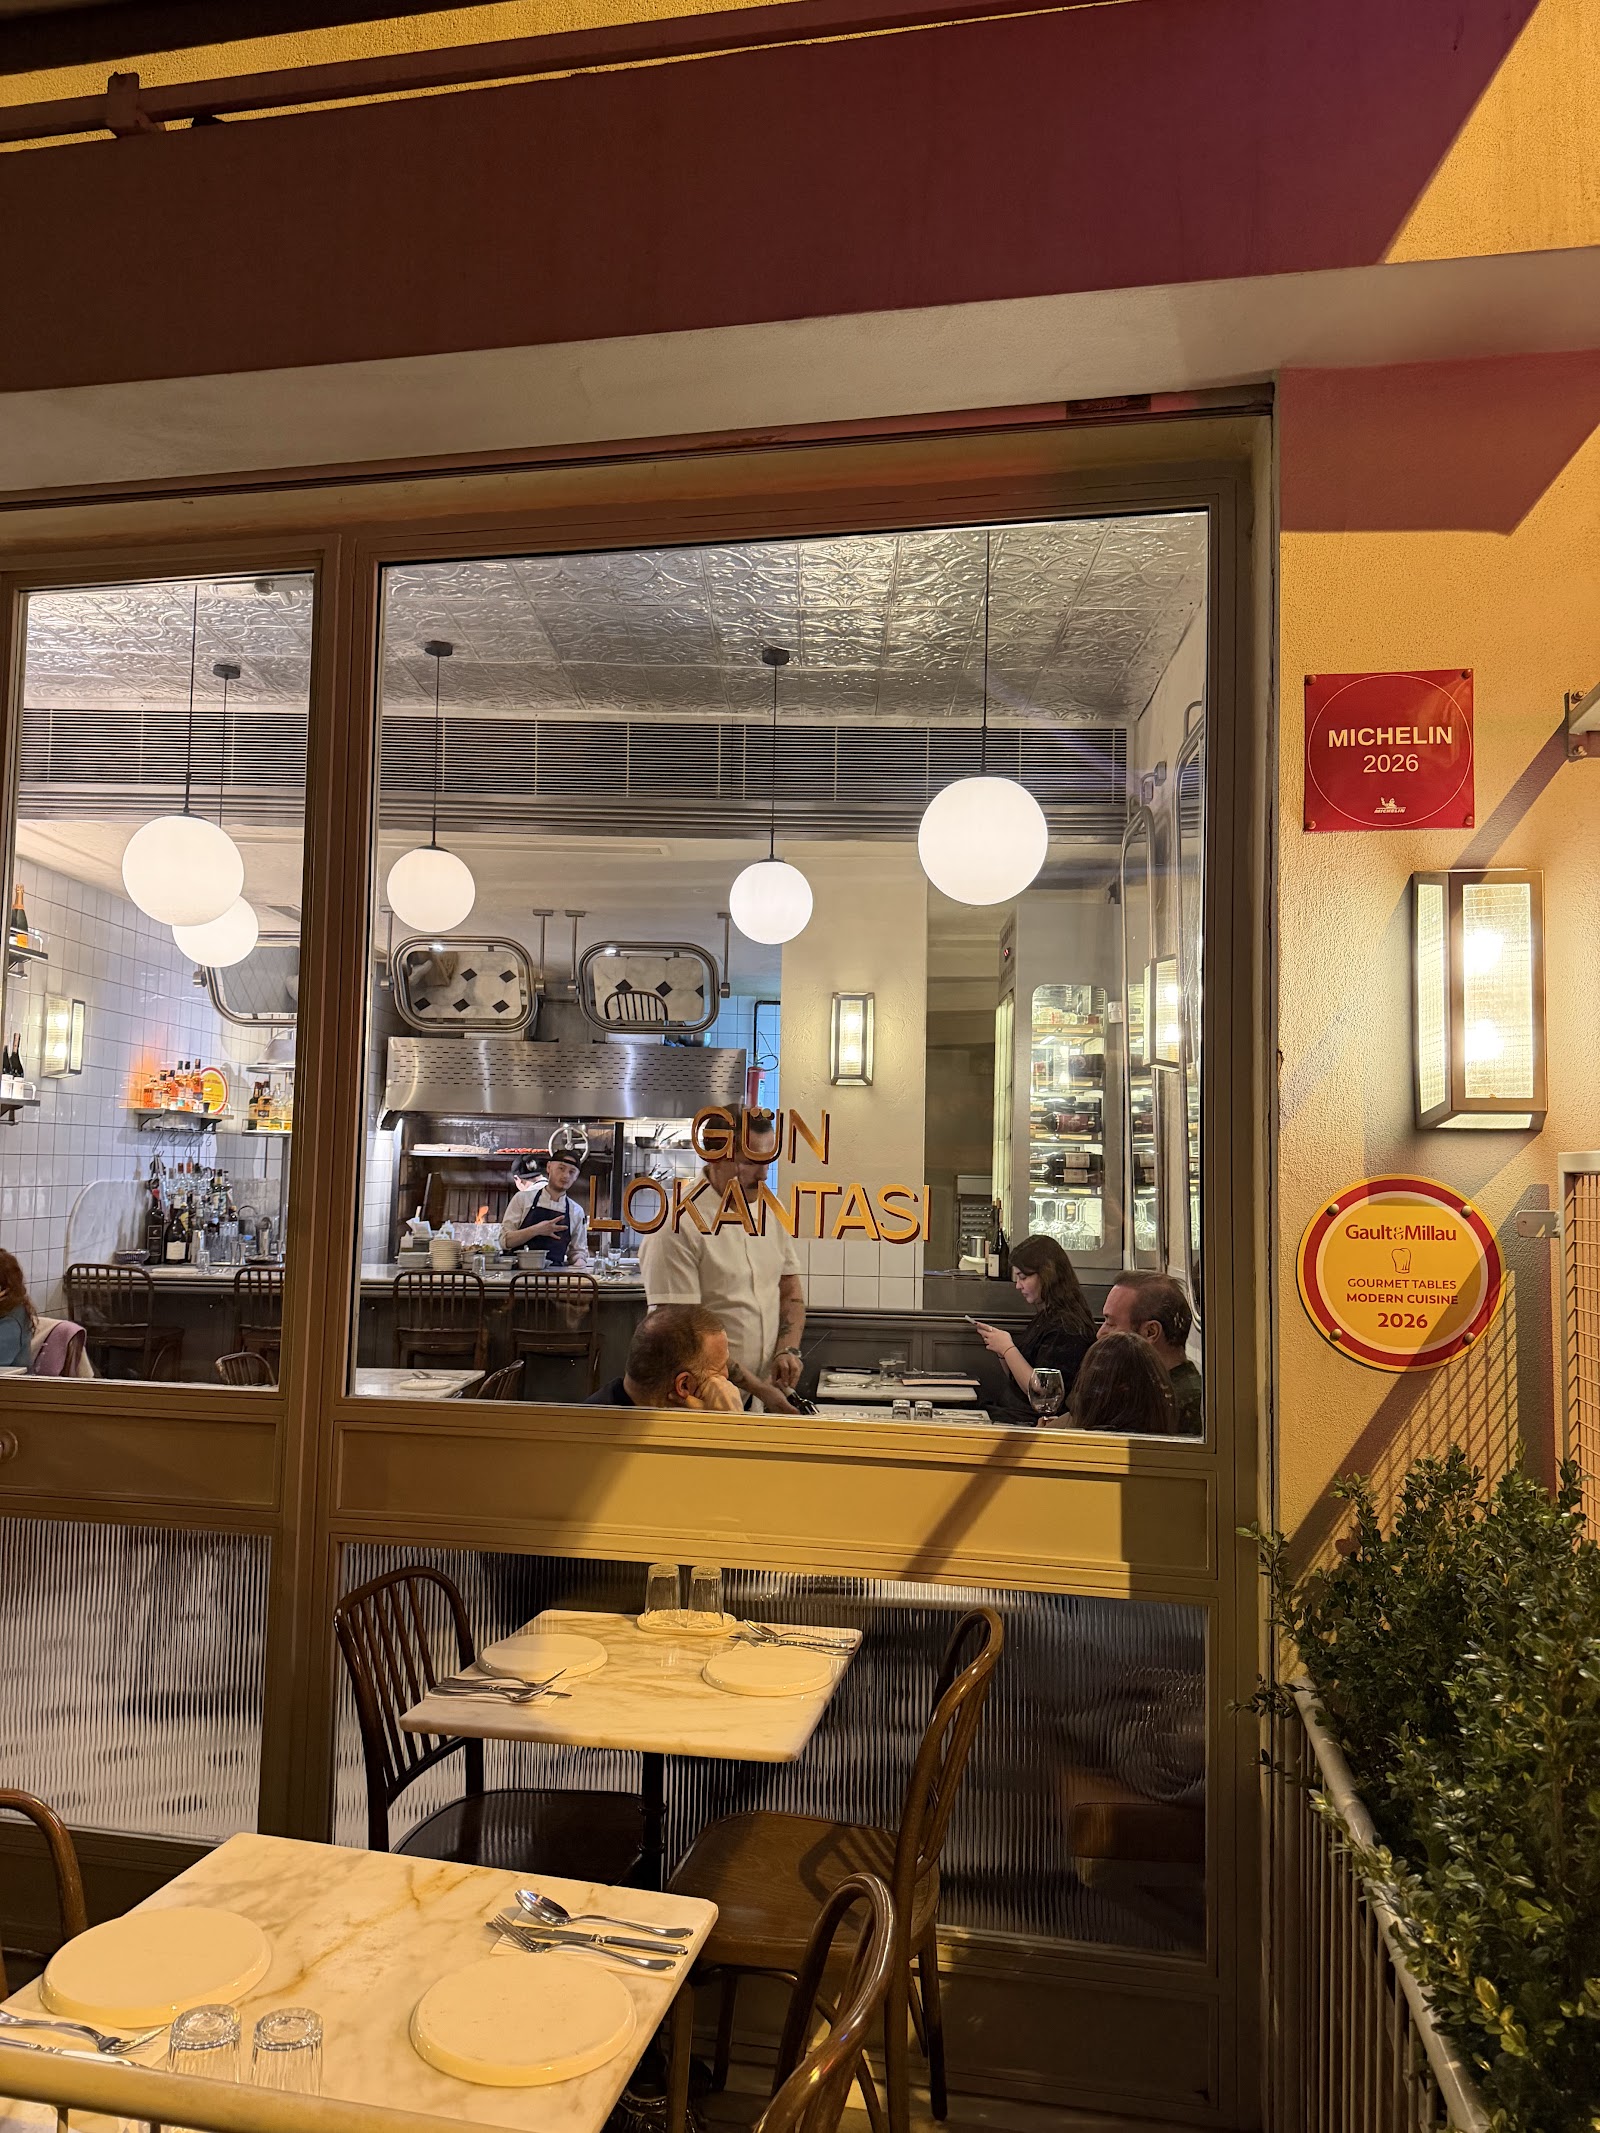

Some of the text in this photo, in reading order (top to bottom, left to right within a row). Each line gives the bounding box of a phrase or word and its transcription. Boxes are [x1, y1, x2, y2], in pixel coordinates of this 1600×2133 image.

[1328, 726, 1452, 748] MICHELIN
[1363, 754, 1419, 773] 2026
[691, 1106, 830, 1164] GÜN
[588, 1175, 931, 1243] LOKANTASI
[1347, 1278, 1457, 1290] GOURMET TABLES
[1346, 1293, 1459, 1305] MODERN CUISINE
[1377, 1312, 1428, 1329] 2026
